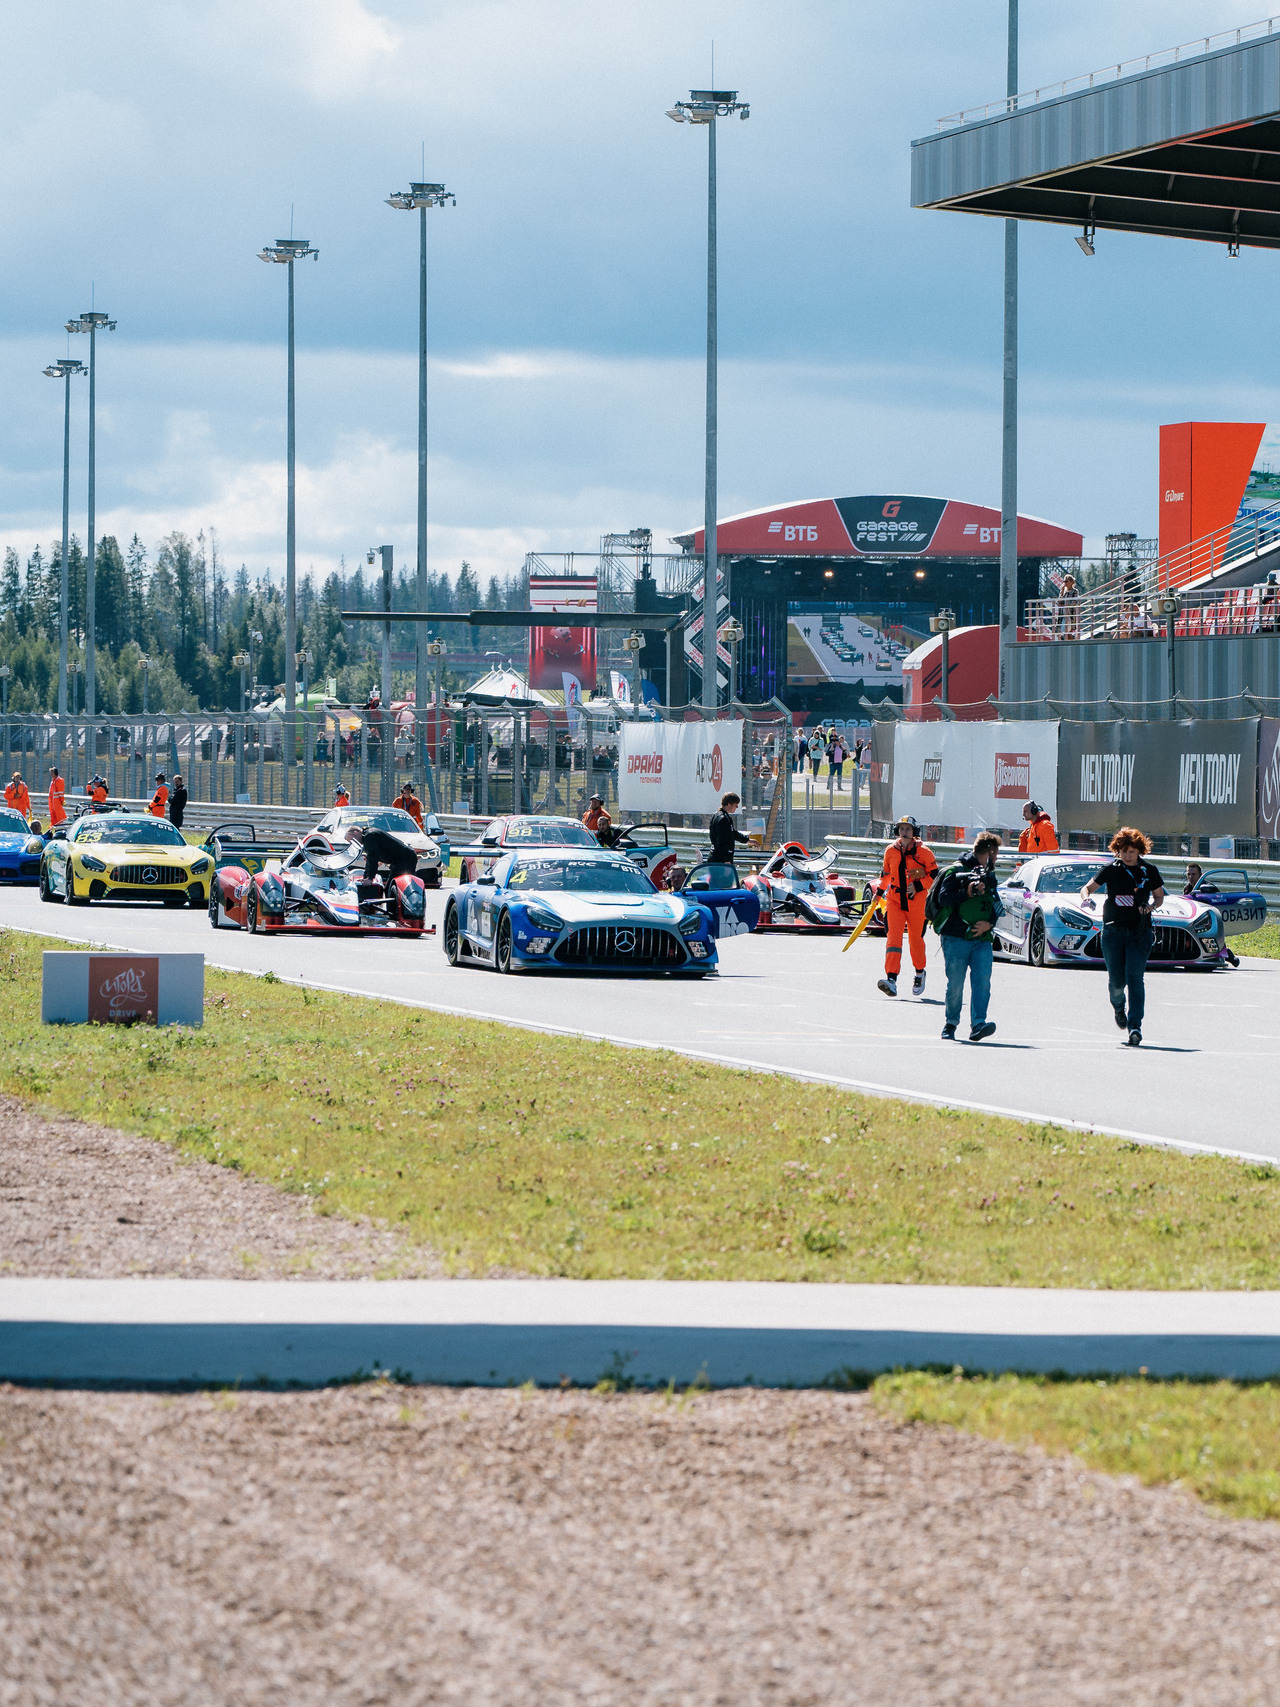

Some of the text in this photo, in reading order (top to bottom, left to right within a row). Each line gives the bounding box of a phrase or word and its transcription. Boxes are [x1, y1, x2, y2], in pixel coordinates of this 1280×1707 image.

[785, 526, 818, 541] ВТБ
[980, 528, 1001, 542] ВТ
[1080, 753, 1135, 802] MEN TODAY
[1178, 753, 1241, 804] MEN TODAY
[75, 832, 103, 843] 83
[507, 828, 533, 838] 98
[620, 865, 641, 875] ВТБ
[1054, 865, 1073, 874] ВТБ
[509, 869, 528, 884] 4
[109, 1009, 137, 1017] DRIVE
